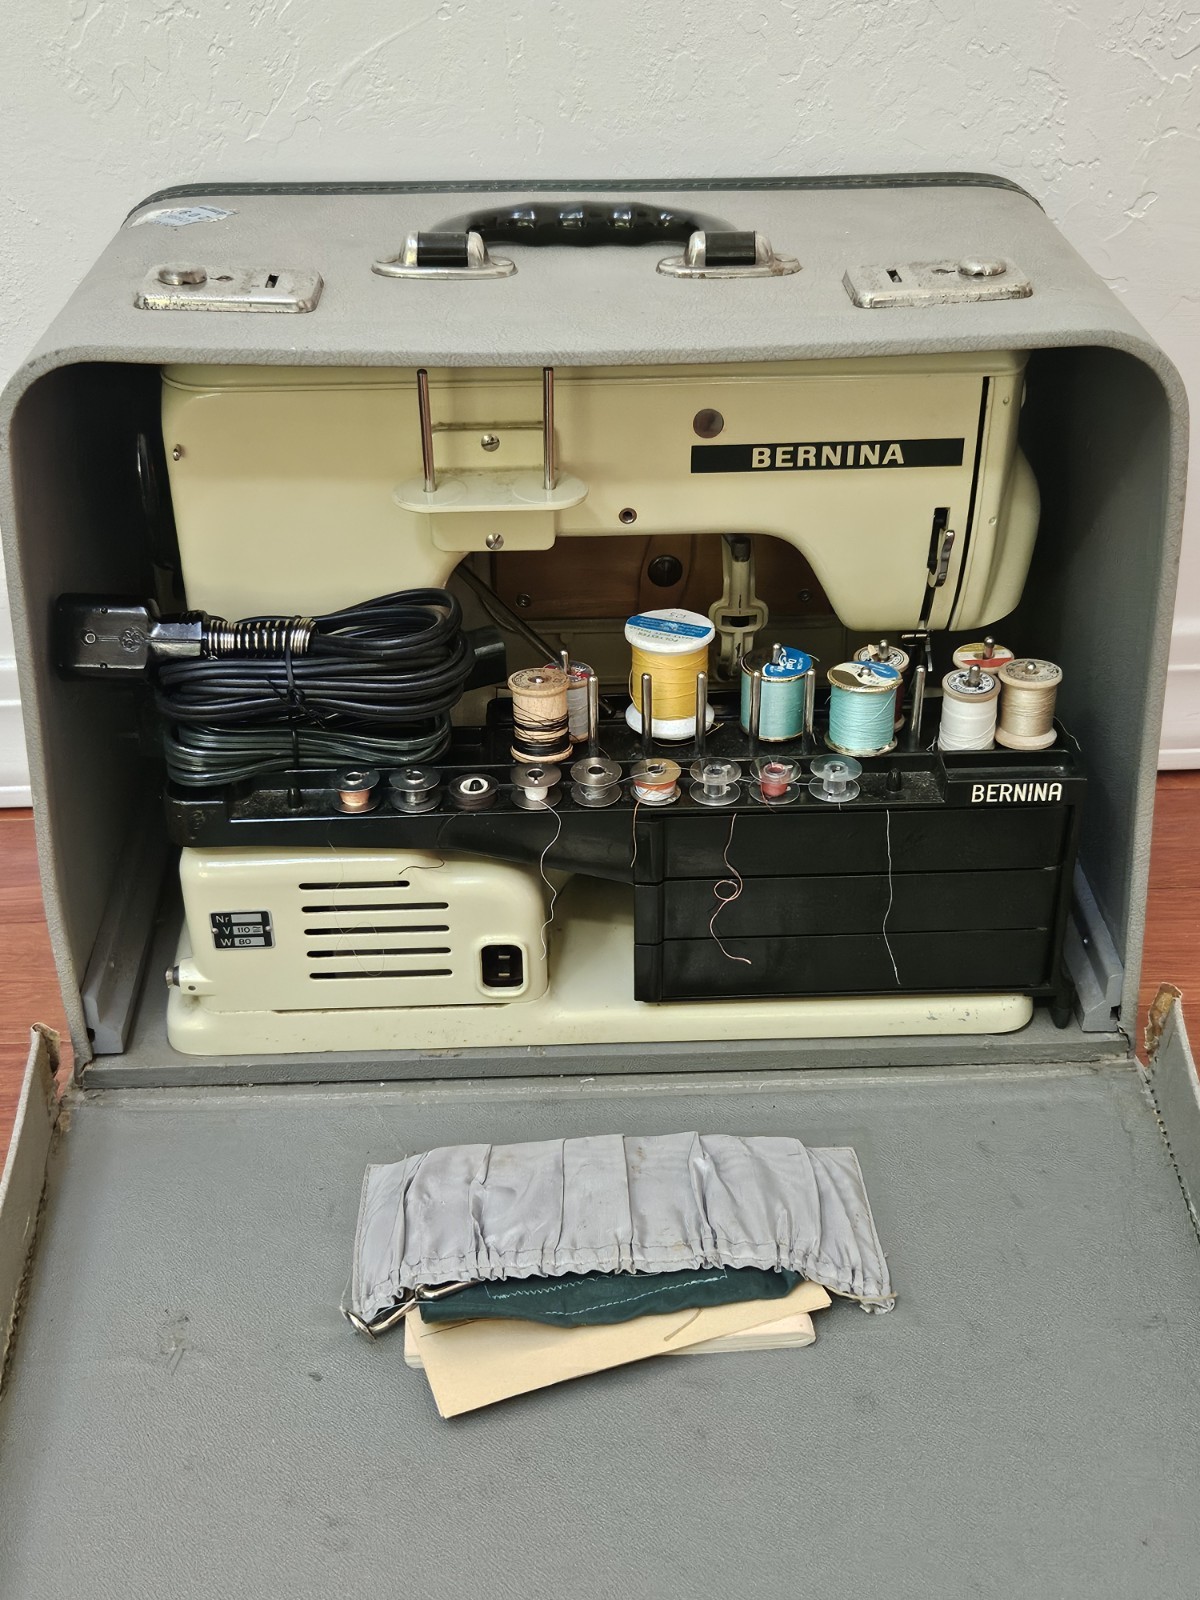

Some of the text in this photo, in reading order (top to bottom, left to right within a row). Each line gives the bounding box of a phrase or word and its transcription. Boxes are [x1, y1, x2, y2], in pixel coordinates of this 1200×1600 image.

[751, 443, 905, 469] BERNINA
[637, 631, 679, 643] POLYESTER
[971, 782, 1063, 803] BERNINA
[215, 915, 229, 923] Nr
[222, 926, 231, 935] V
[220, 938, 232, 947] W
